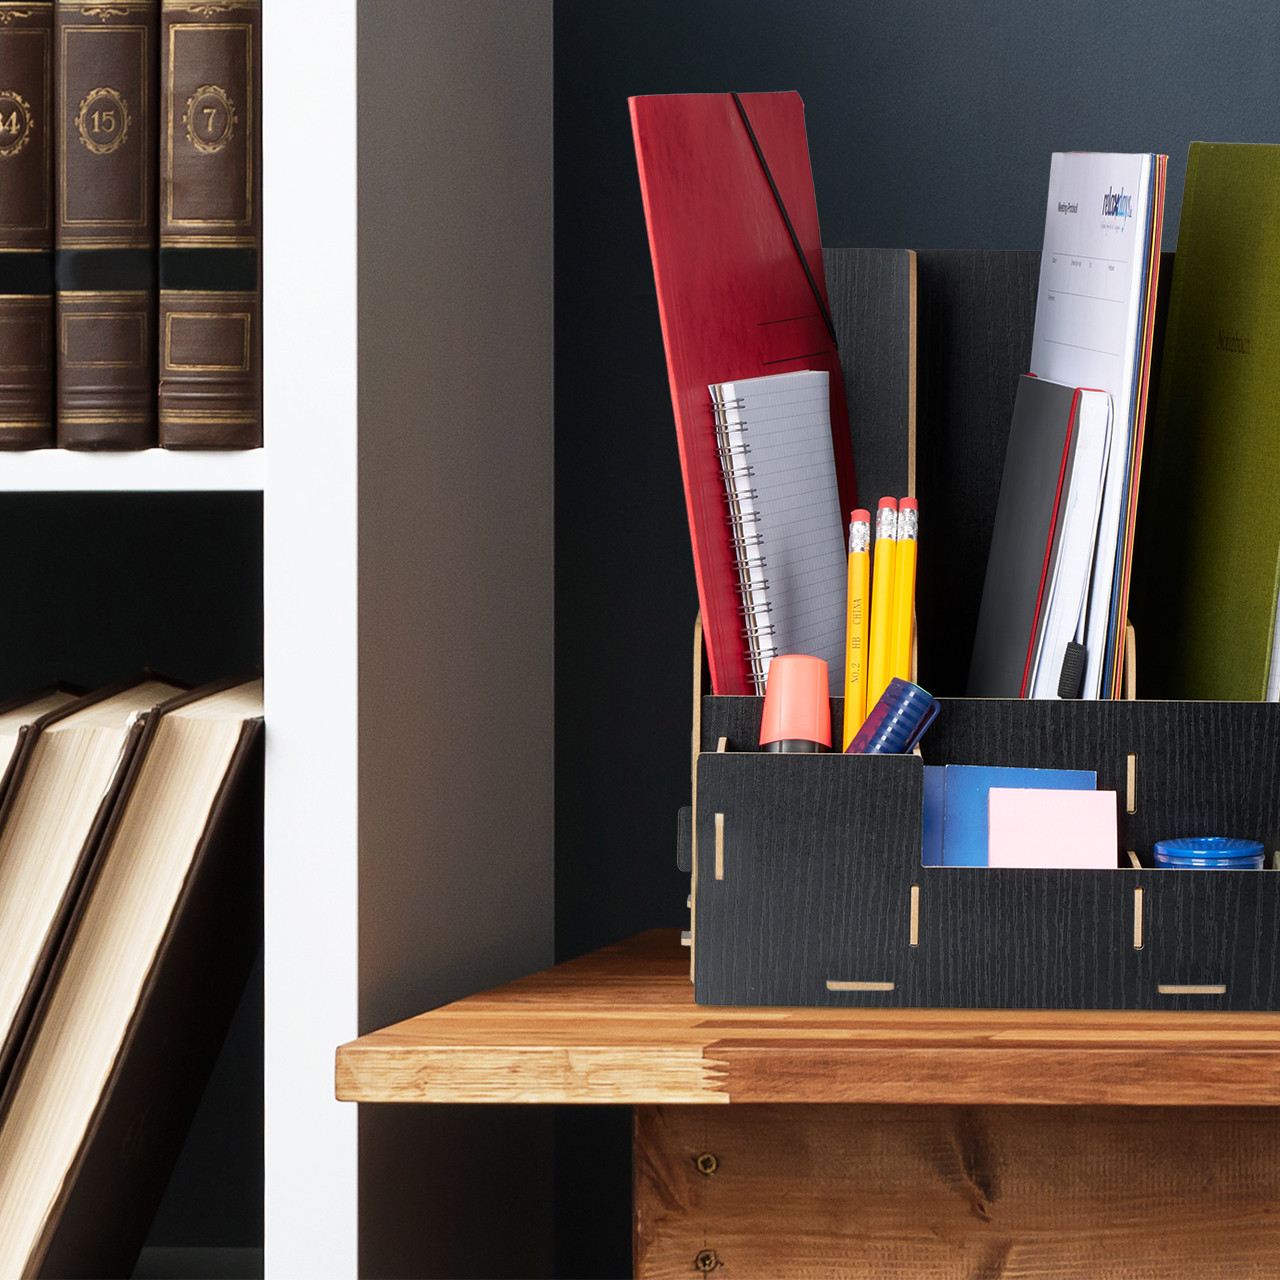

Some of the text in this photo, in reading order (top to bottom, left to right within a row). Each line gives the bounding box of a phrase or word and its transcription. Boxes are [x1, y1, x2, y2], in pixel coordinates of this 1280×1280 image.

[91, 110, 116, 133] 15
[203, 108, 217, 132] 7
[851, 598, 862, 683] NO.2 HB CHINA
